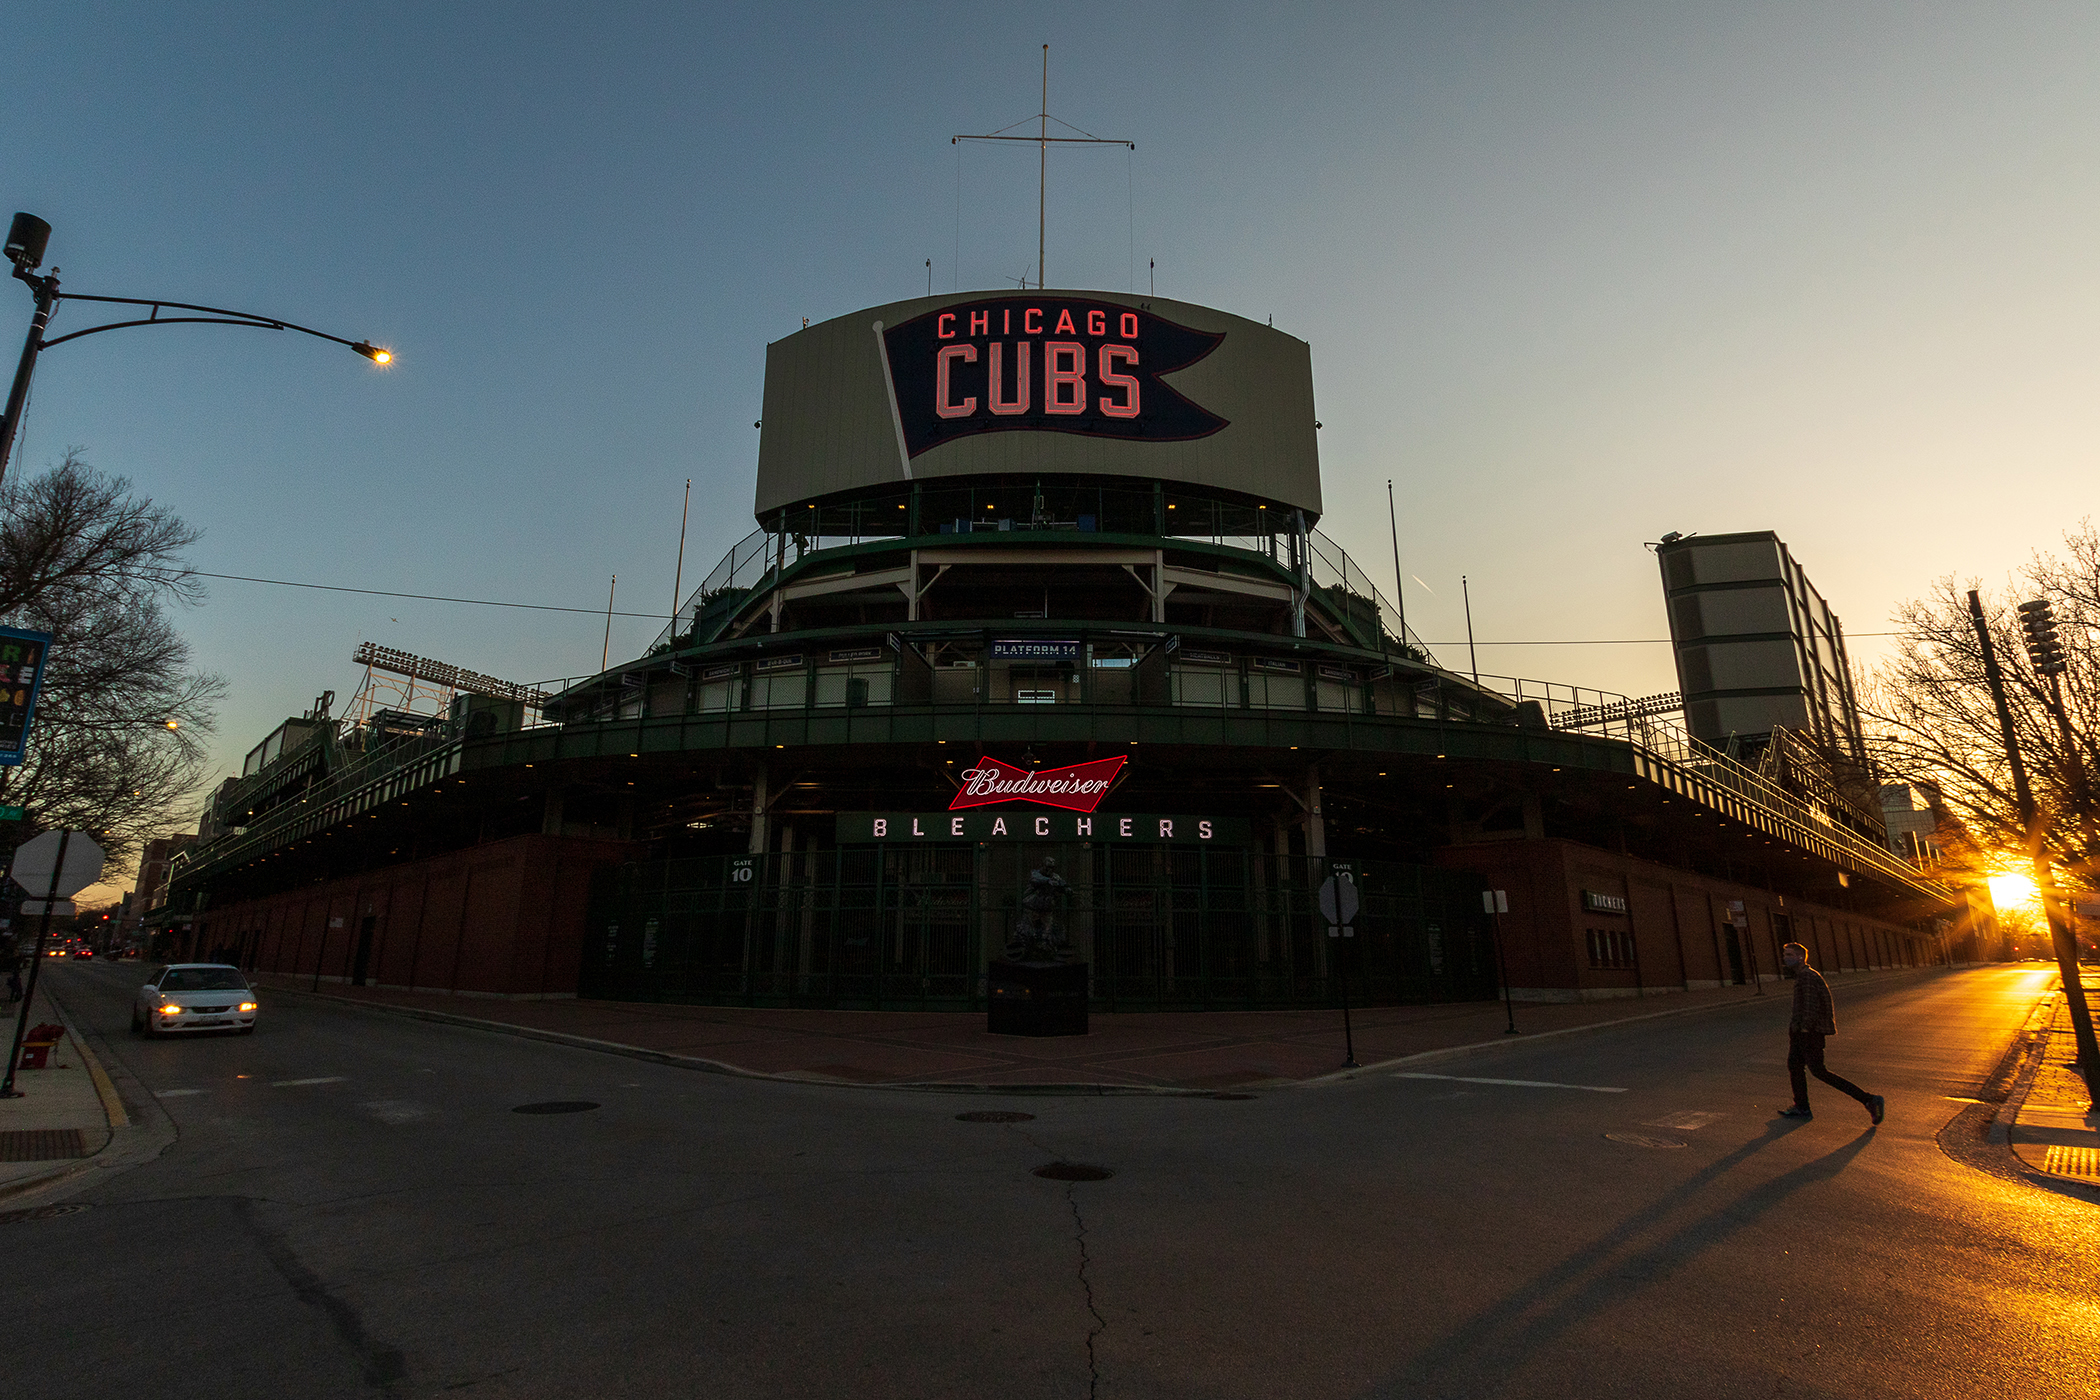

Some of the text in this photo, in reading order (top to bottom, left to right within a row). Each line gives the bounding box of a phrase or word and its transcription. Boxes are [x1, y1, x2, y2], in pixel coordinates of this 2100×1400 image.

[937, 308, 1139, 339] CHICAGO
[935, 341, 1141, 419] CUBS
[994, 644, 1076, 655] PLATFORM 14
[962, 766, 1109, 796] Budweiser
[872, 817, 1213, 839] BLEACHERS
[732, 859, 753, 867] GATE
[1332, 862, 1353, 871] GATE
[731, 867, 753, 882] 10
